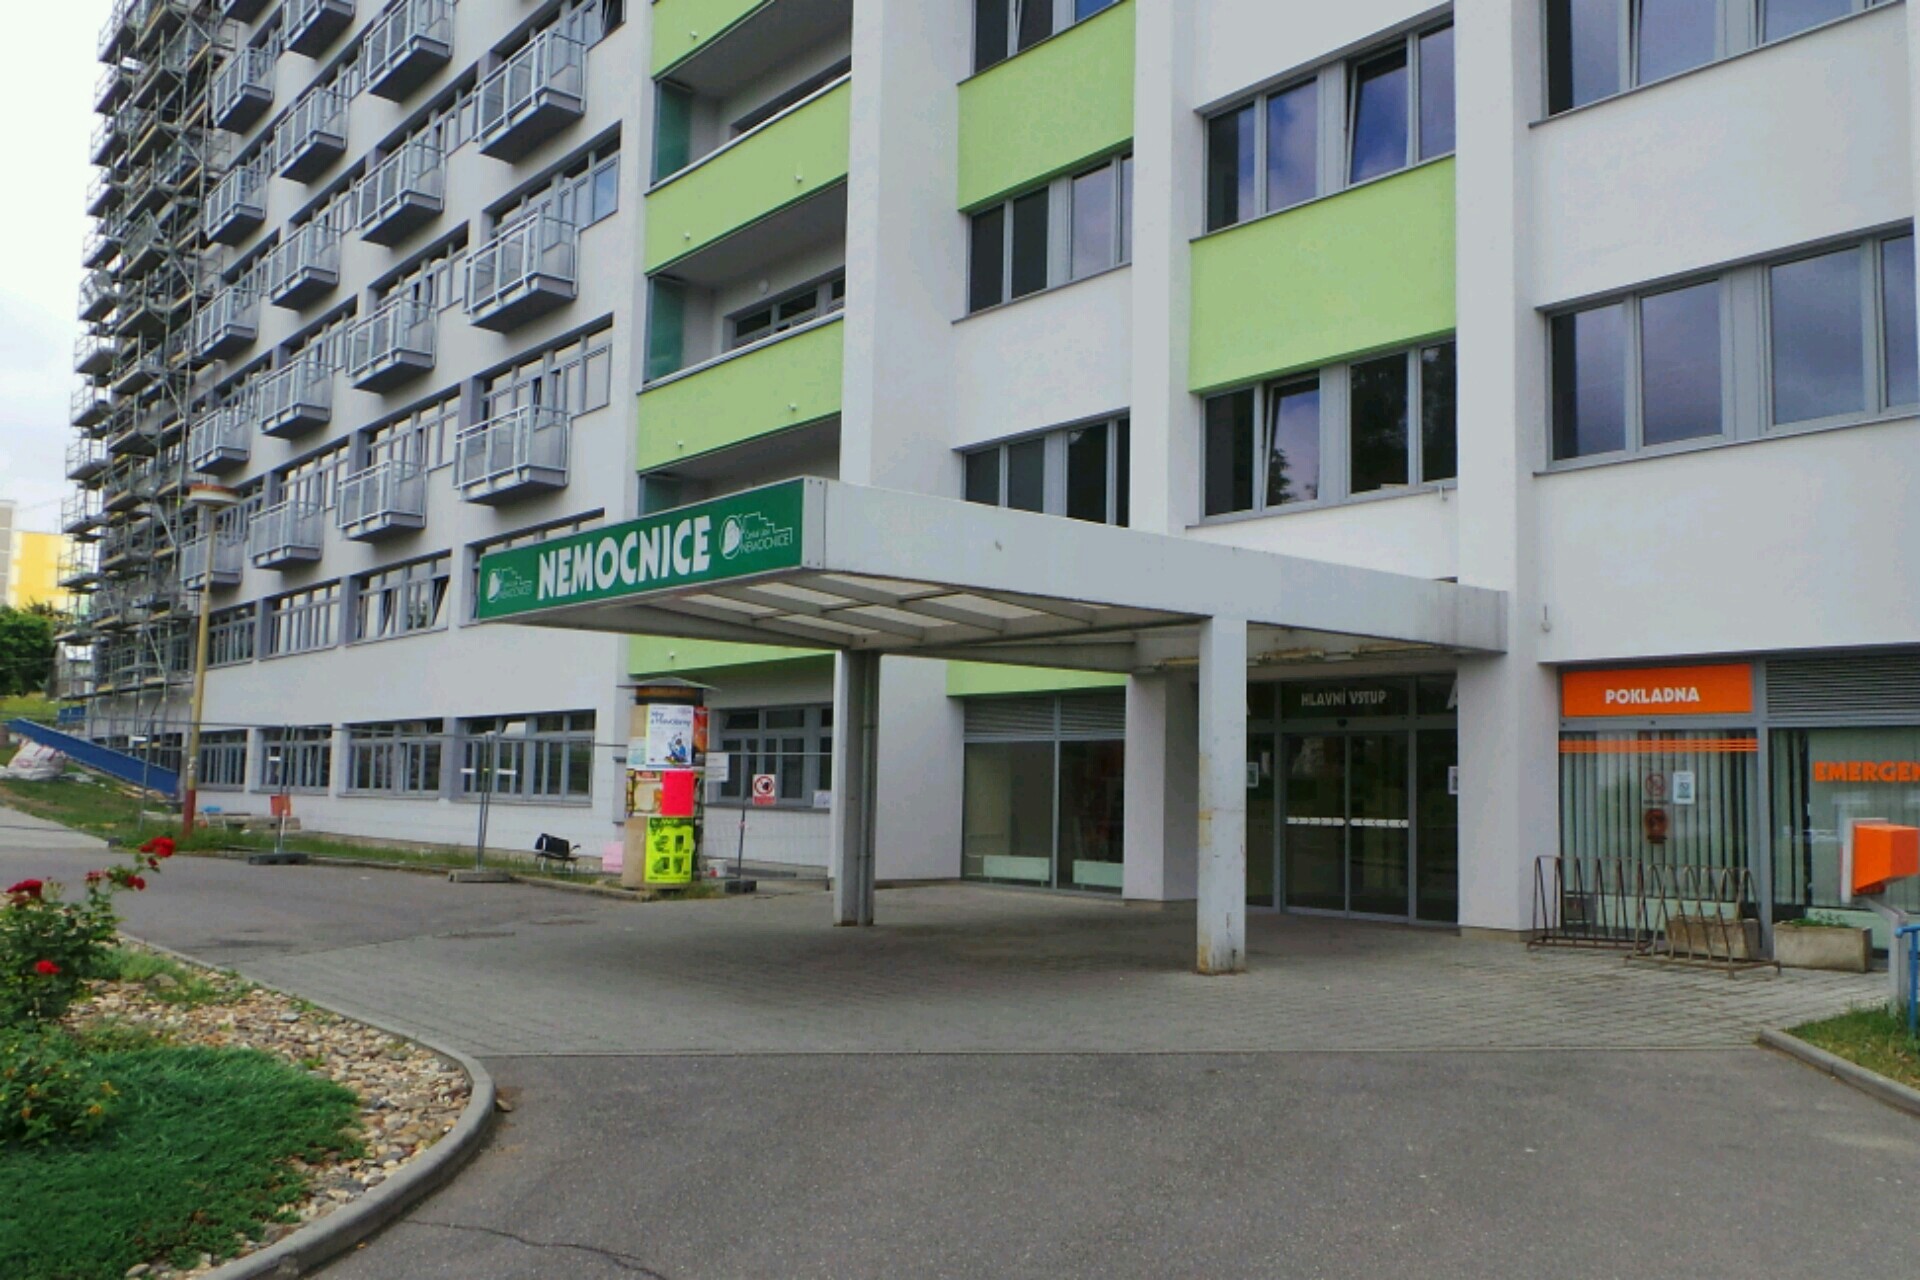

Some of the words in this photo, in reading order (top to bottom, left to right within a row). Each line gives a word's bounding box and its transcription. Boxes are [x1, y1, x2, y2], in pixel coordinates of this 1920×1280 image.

[537, 515, 712, 601] NEMOCNICE
[1301, 687, 1346, 706] HLAVNÍ
[1349, 690, 1387, 705] VSTUP
[1605, 686, 1700, 705] POKLADNA
